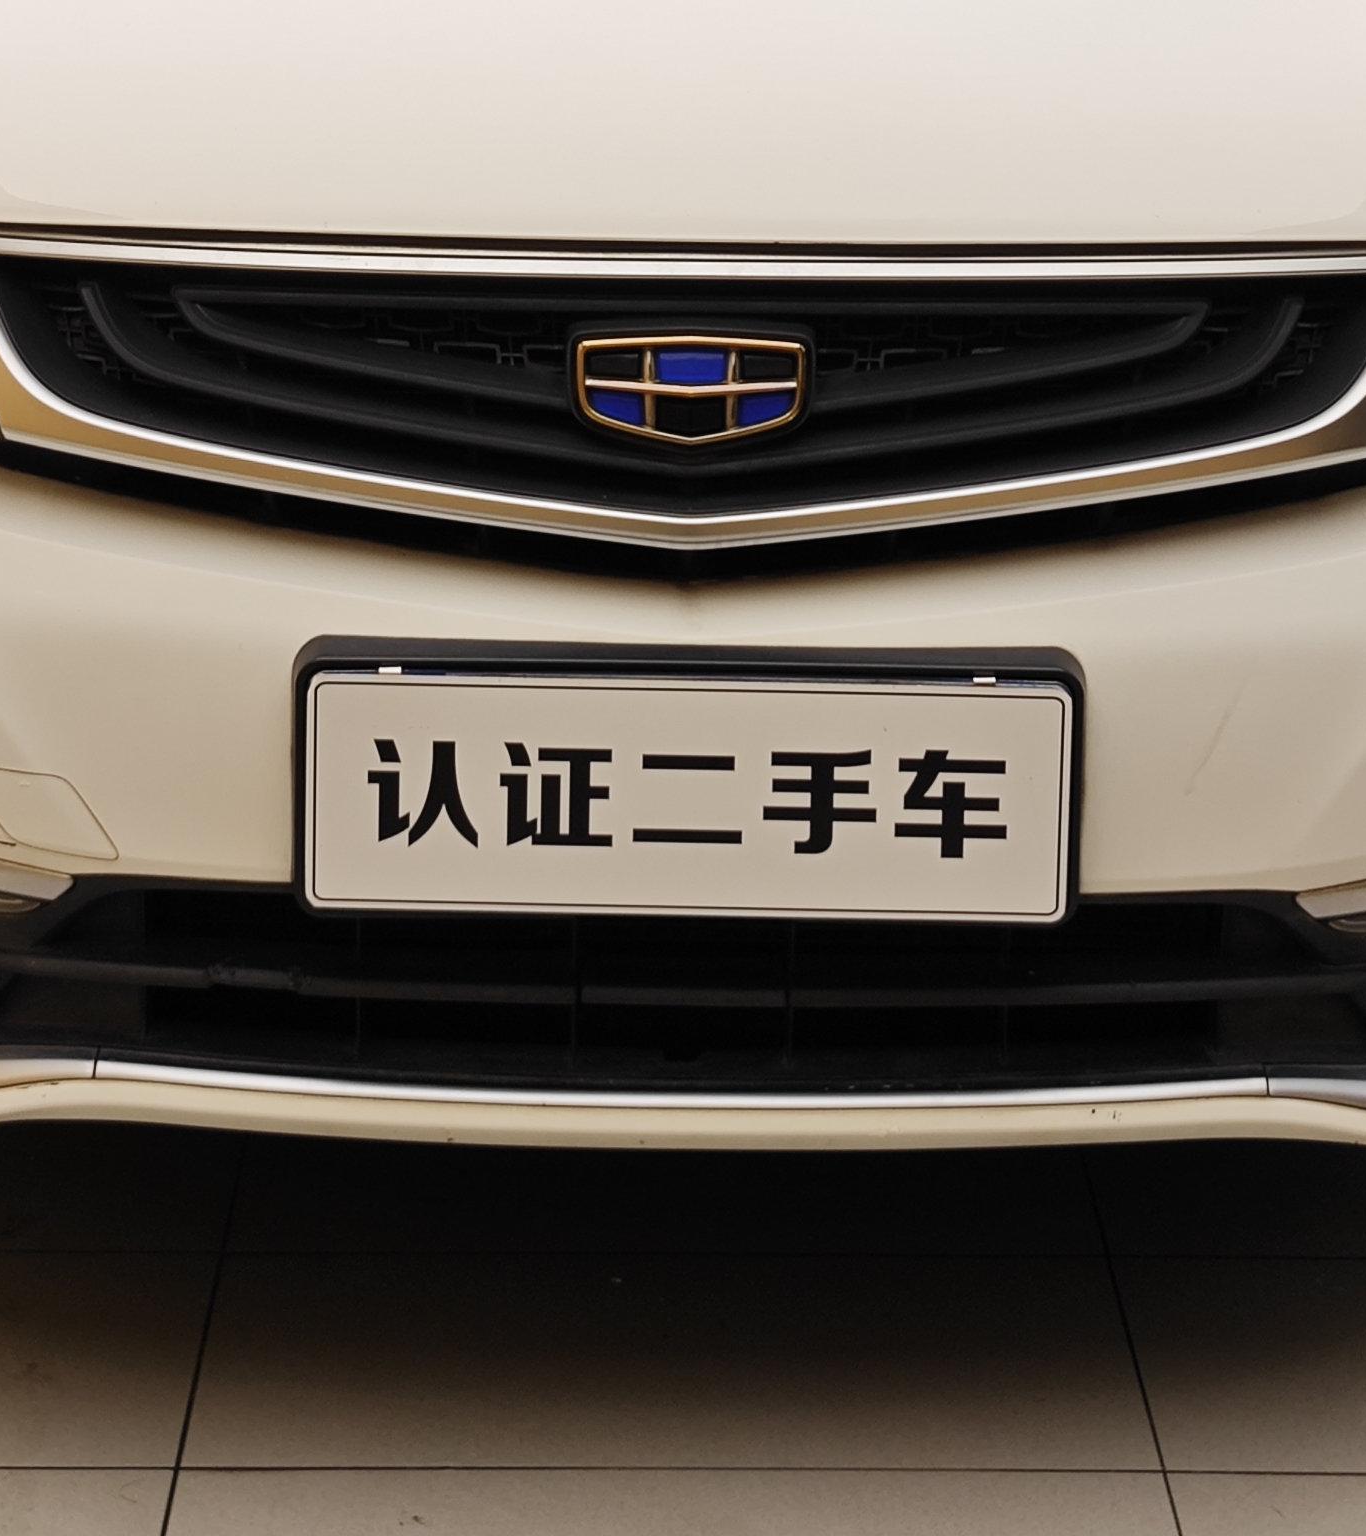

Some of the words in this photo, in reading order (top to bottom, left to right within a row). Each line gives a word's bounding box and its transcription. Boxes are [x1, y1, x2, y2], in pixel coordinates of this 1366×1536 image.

[367, 738, 1007, 859] 认证二手车
